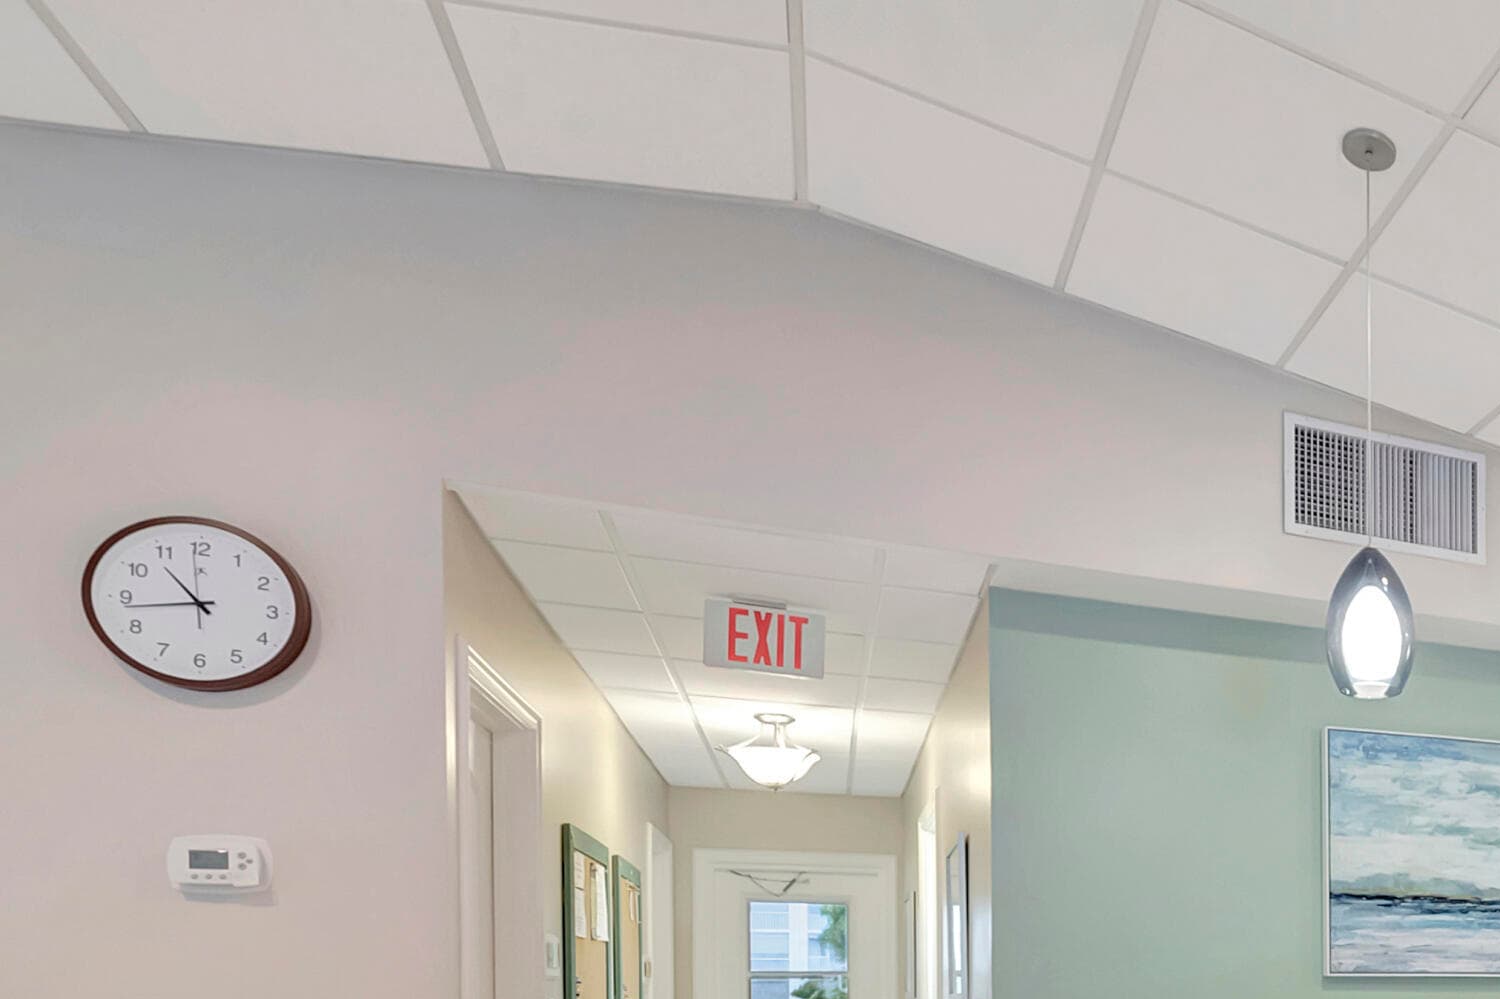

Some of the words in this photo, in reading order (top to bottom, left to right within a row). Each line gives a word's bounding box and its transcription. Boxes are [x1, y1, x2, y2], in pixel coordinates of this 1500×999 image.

[155, 546, 172, 560] 11
[190, 542, 211, 557] 12
[233, 554, 241, 567] 1
[129, 563, 148, 578] 10
[257, 577, 270, 591] 2
[120, 590, 132, 604] 9
[266, 606, 278, 619] 3
[130, 620, 142, 634] 8
[256, 632, 268, 645] 4
[727, 607, 809, 670] EXIT
[157, 643, 170, 656] 7
[230, 650, 242, 663] 5
[194, 654, 206, 668] 6
